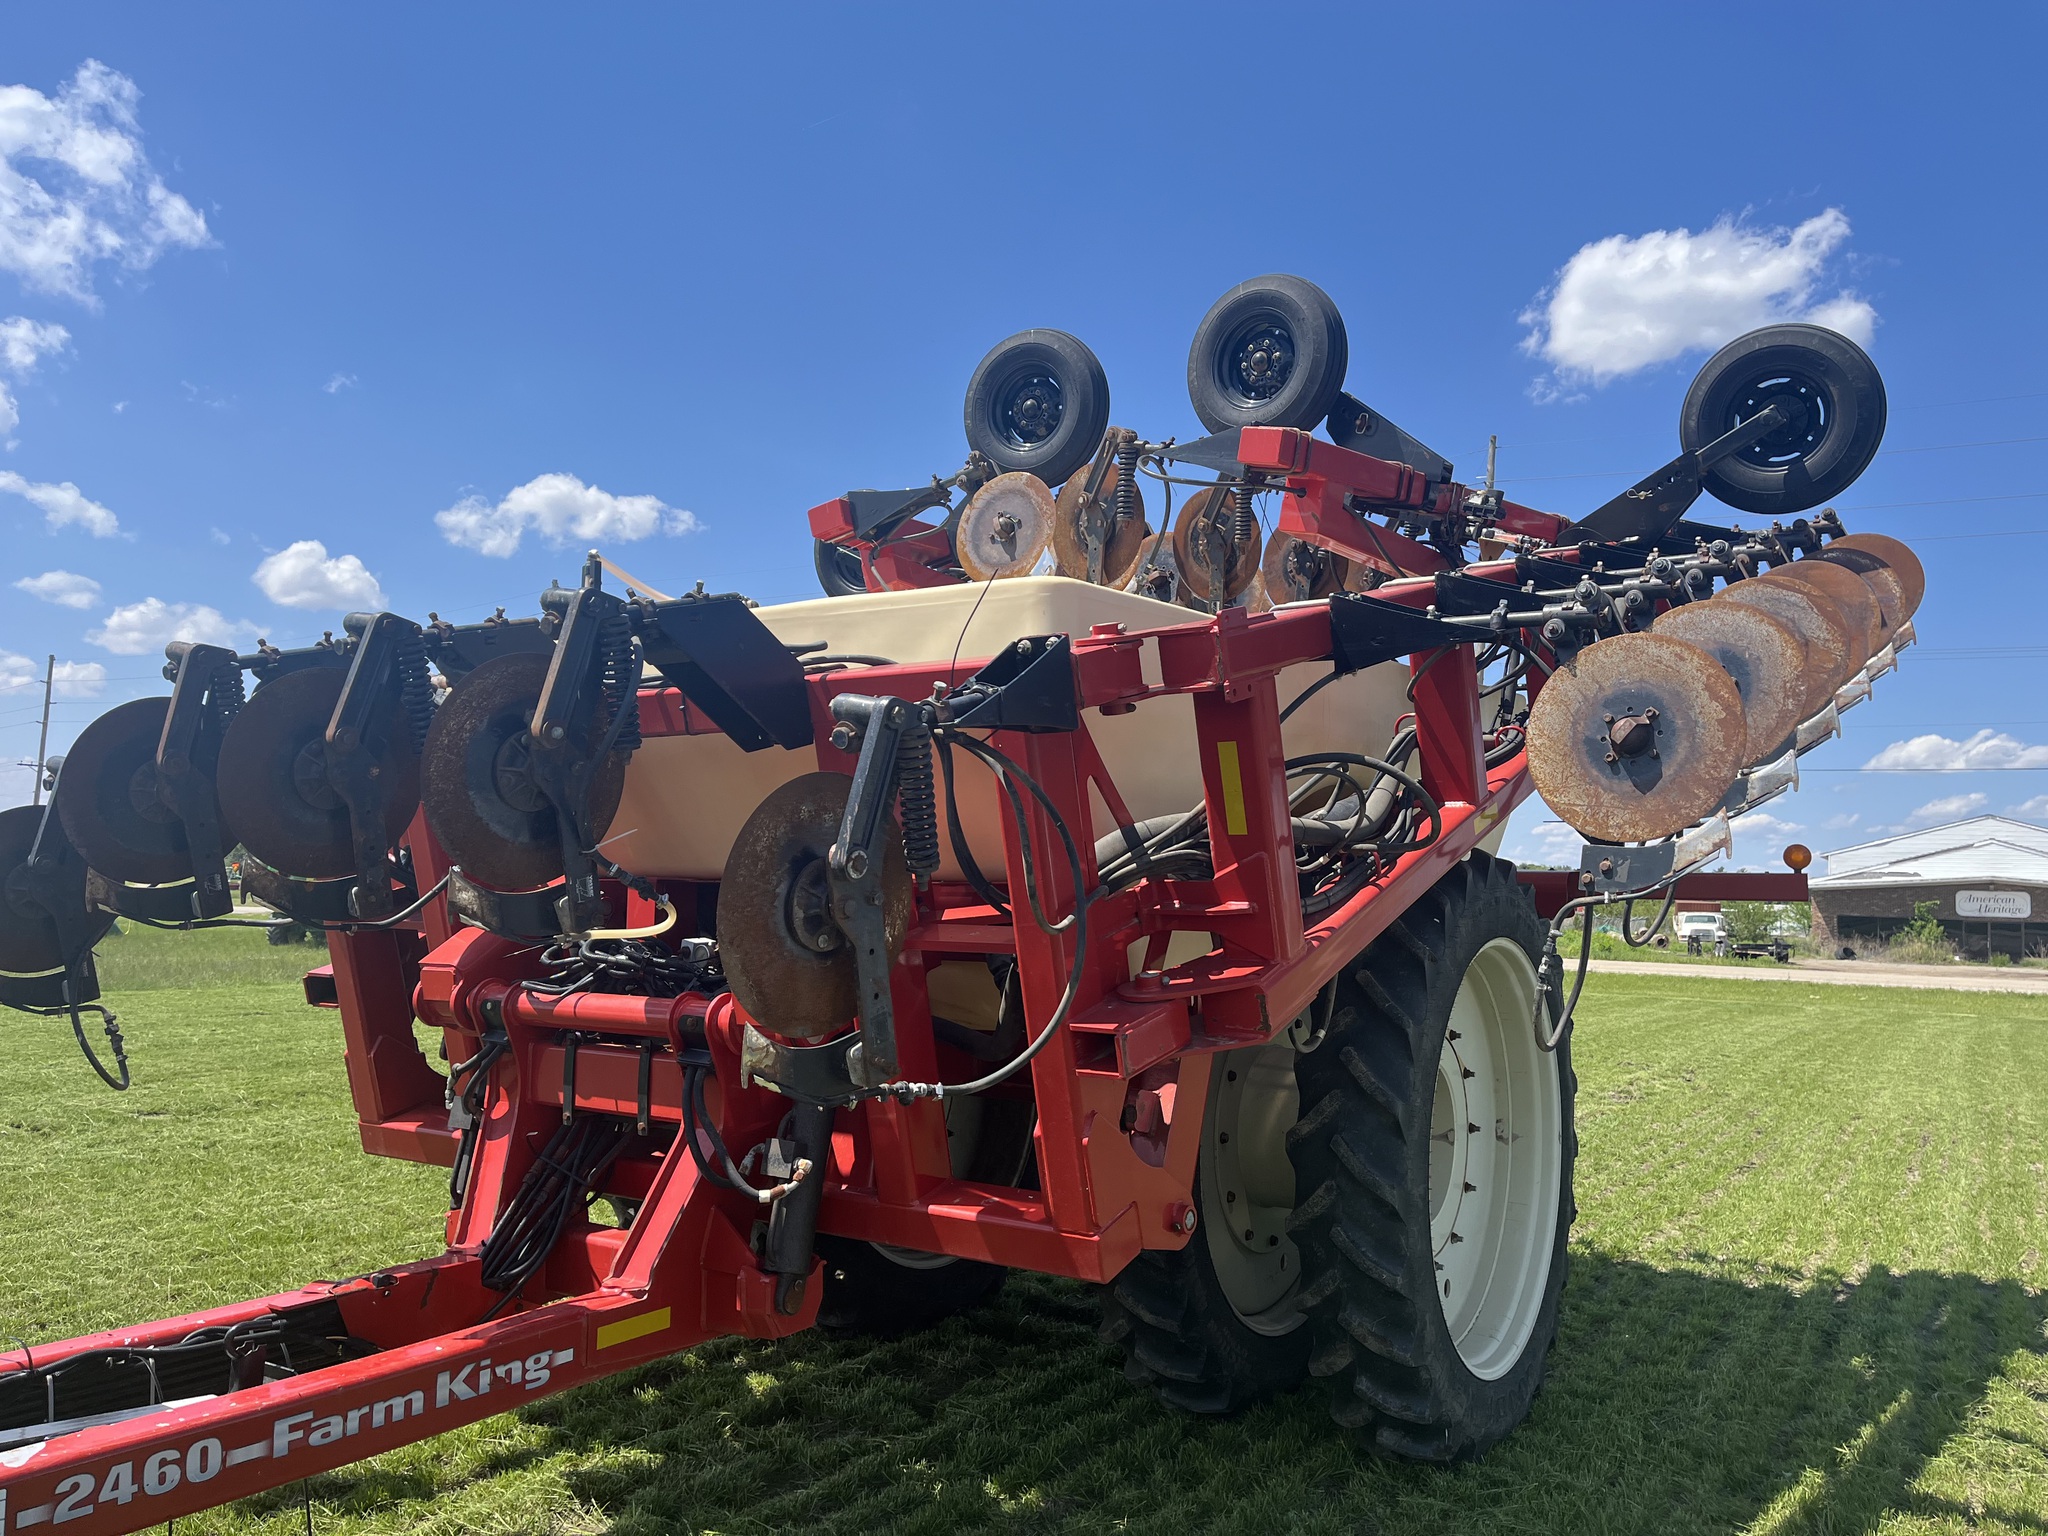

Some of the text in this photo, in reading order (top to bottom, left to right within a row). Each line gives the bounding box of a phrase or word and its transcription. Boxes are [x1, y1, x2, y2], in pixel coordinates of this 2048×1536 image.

[1964, 894, 2016, 904] American
[1978, 903, 2024, 916] Heritage
[272, 1390, 425, 1458] Farm
[435, 1349, 554, 1409] King
